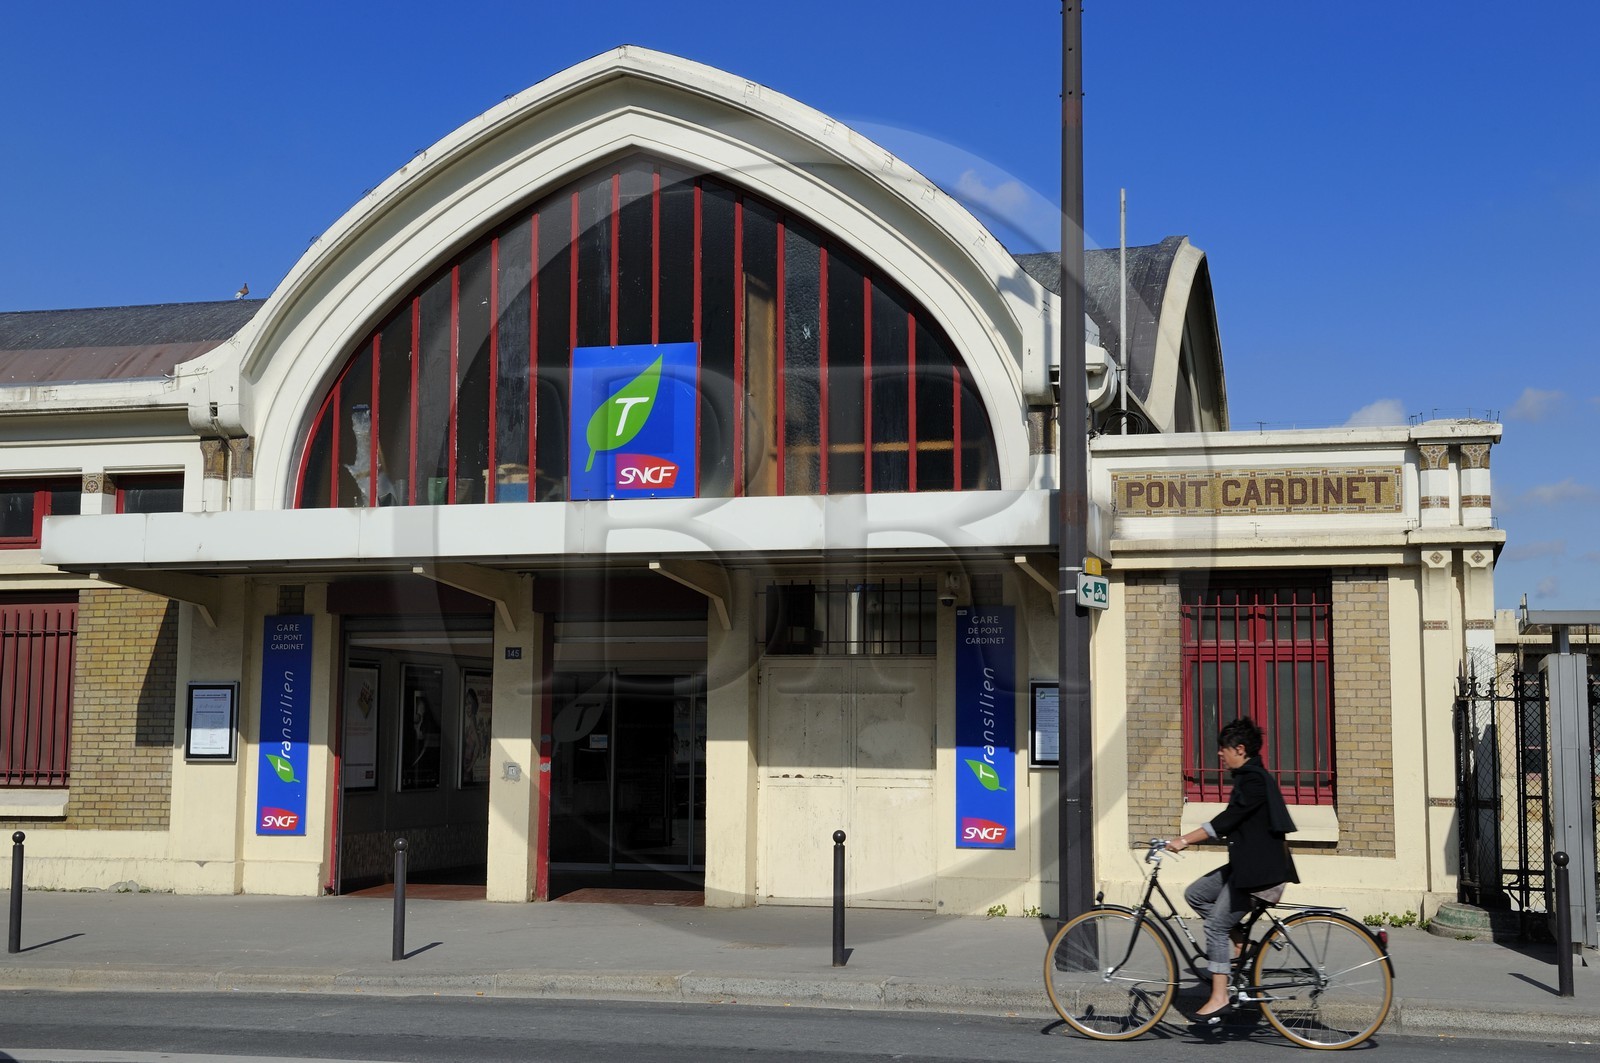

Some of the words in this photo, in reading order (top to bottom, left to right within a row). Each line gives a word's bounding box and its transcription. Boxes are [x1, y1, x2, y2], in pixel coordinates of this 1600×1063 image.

[615, 397, 650, 436] T
[618, 466, 676, 485] SNCF
[1126, 481, 1208, 508] PONT
[1222, 476, 1389, 507] CARDINET
[971, 615, 999, 624] GARE
[276, 623, 300, 632] GARE
[967, 627, 979, 635] DE
[981, 627, 1003, 635] PONT
[965, 637, 1006, 645] CARDINET
[507, 649, 520, 658] 145
[277, 671, 294, 771] Transilien
[979, 667, 995, 778] Transilien
[262, 815, 298, 827] SNCF
[963, 826, 1005, 840] SNCF
